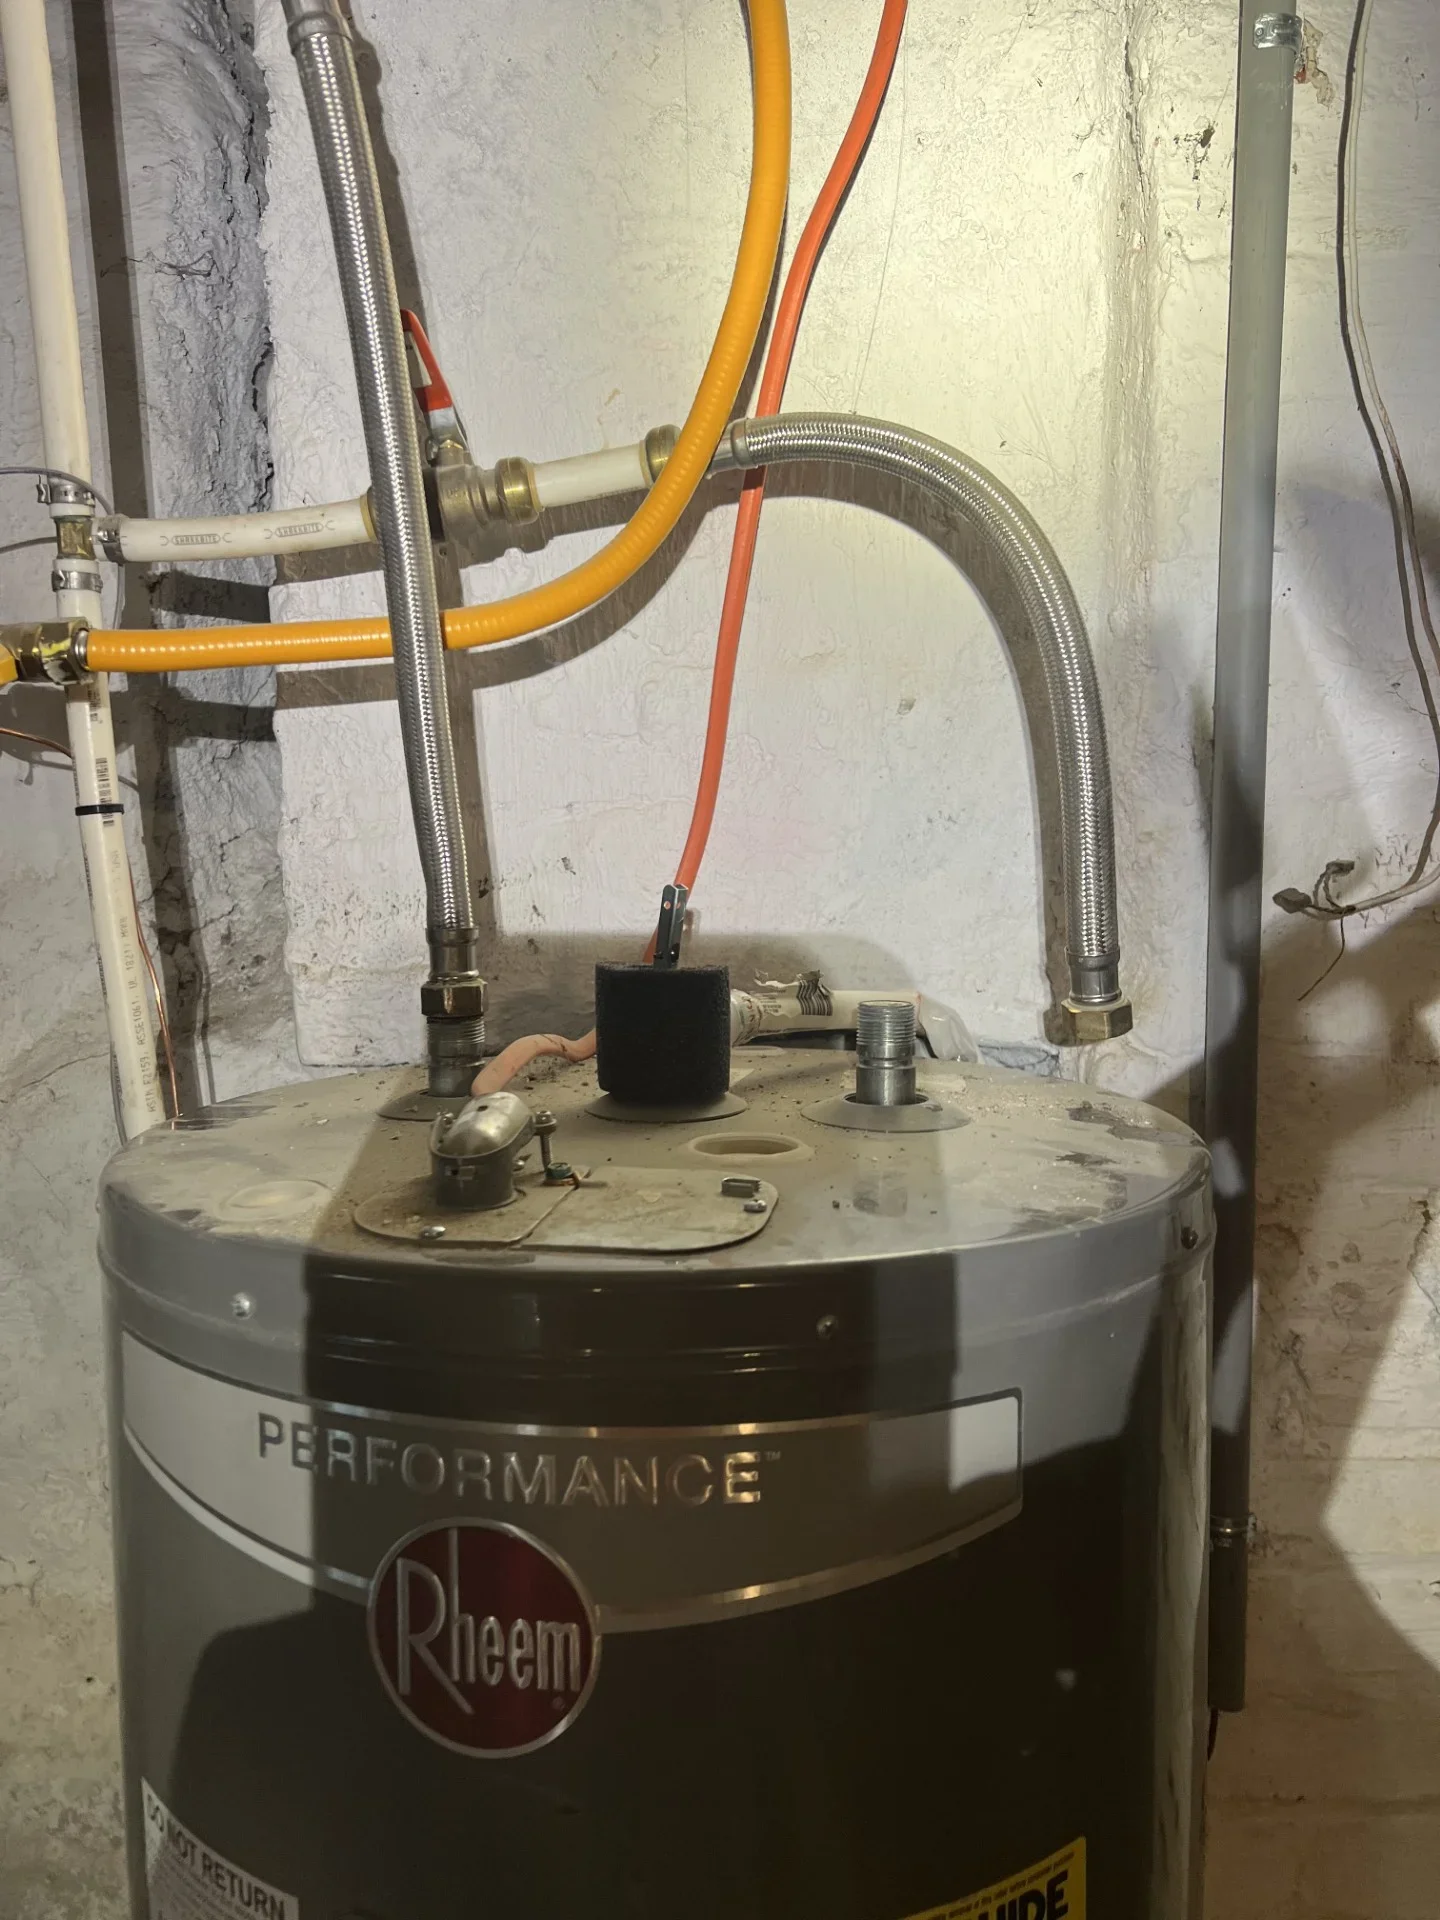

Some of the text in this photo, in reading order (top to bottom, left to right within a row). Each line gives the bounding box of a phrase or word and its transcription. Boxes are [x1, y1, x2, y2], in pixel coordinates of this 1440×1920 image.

[258, 1412, 763, 1506] PERFORMANCE
[396, 1527, 582, 1716] Rheem
[201, 1852, 286, 1920] RETURN
